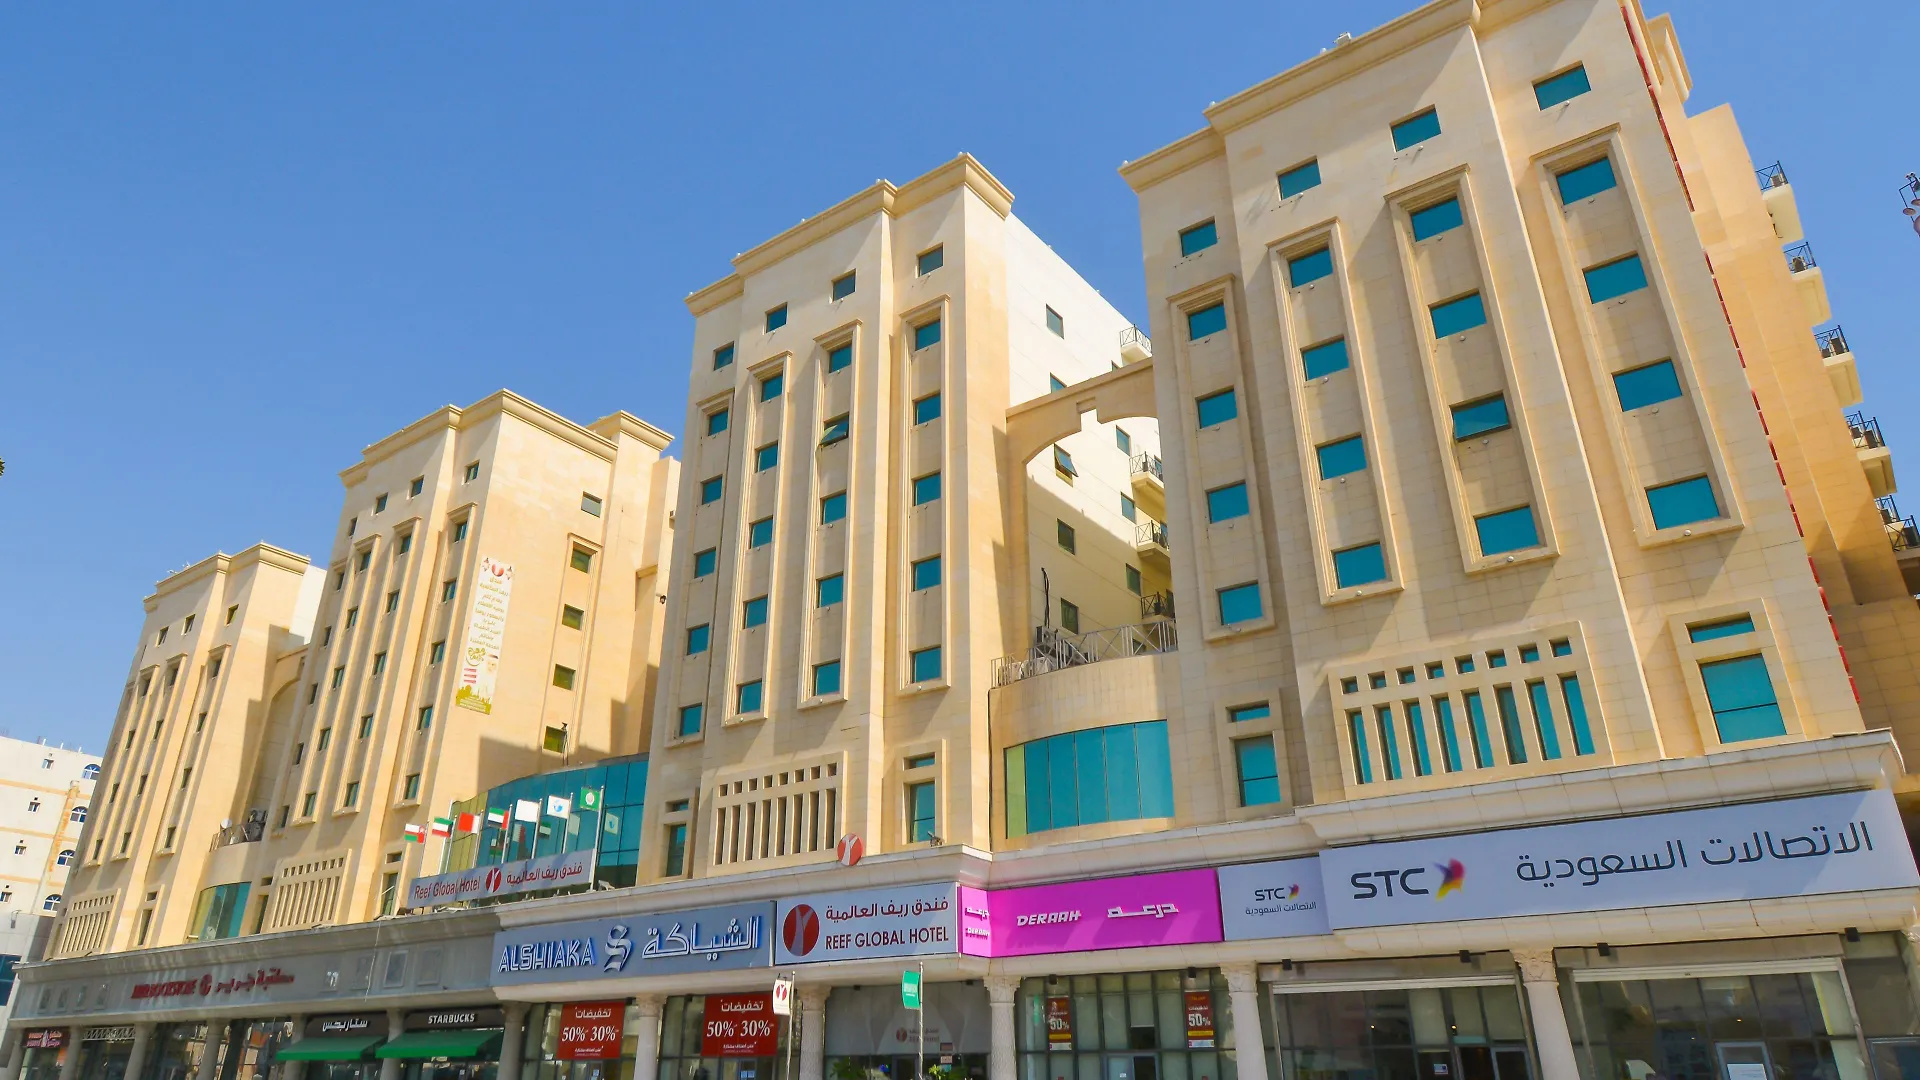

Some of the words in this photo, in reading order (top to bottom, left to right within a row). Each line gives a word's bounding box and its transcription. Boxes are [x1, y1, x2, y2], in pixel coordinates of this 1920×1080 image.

[1700, 821, 1874, 866] الاتصالات
[541, 865, 559, 881] ريف
[560, 861, 583, 879] فندق
[1516, 839, 1688, 888] السعودية
[506, 867, 541, 887] العالمية
[1350, 867, 1430, 900] STC
[414, 882, 432, 900] Reef
[433, 879, 457, 897] Global
[460, 875, 480, 893] Hotel
[1254, 887, 1286, 901] STC
[825, 903, 878, 923] العالمية
[881, 899, 908, 918] ريف
[911, 896, 949, 916] فندق
[1245, 904, 1282, 917] السعودية
[1283, 901, 1317, 912] الاتصالات
[1016, 910, 1082, 927] DERAAH
[641, 915, 761, 961] الشياكة
[825, 933, 851, 950] REEF
[855, 929, 905, 948] GLOBAL
[909, 926, 949, 944] HOTEL
[498, 937, 595, 973] ALSHIAKA
[322, 1017, 368, 1032] ستاربكس
[427, 1013, 475, 1025] STARBUCKS
[706, 1020, 734, 1038] 50%
[740, 1019, 771, 1037] 30%
[1049, 1018, 1070, 1030] 50%
[1188, 1013, 1211, 1027] 50%
[561, 1026, 586, 1042] 50%
[590, 1025, 616, 1042] 30%
